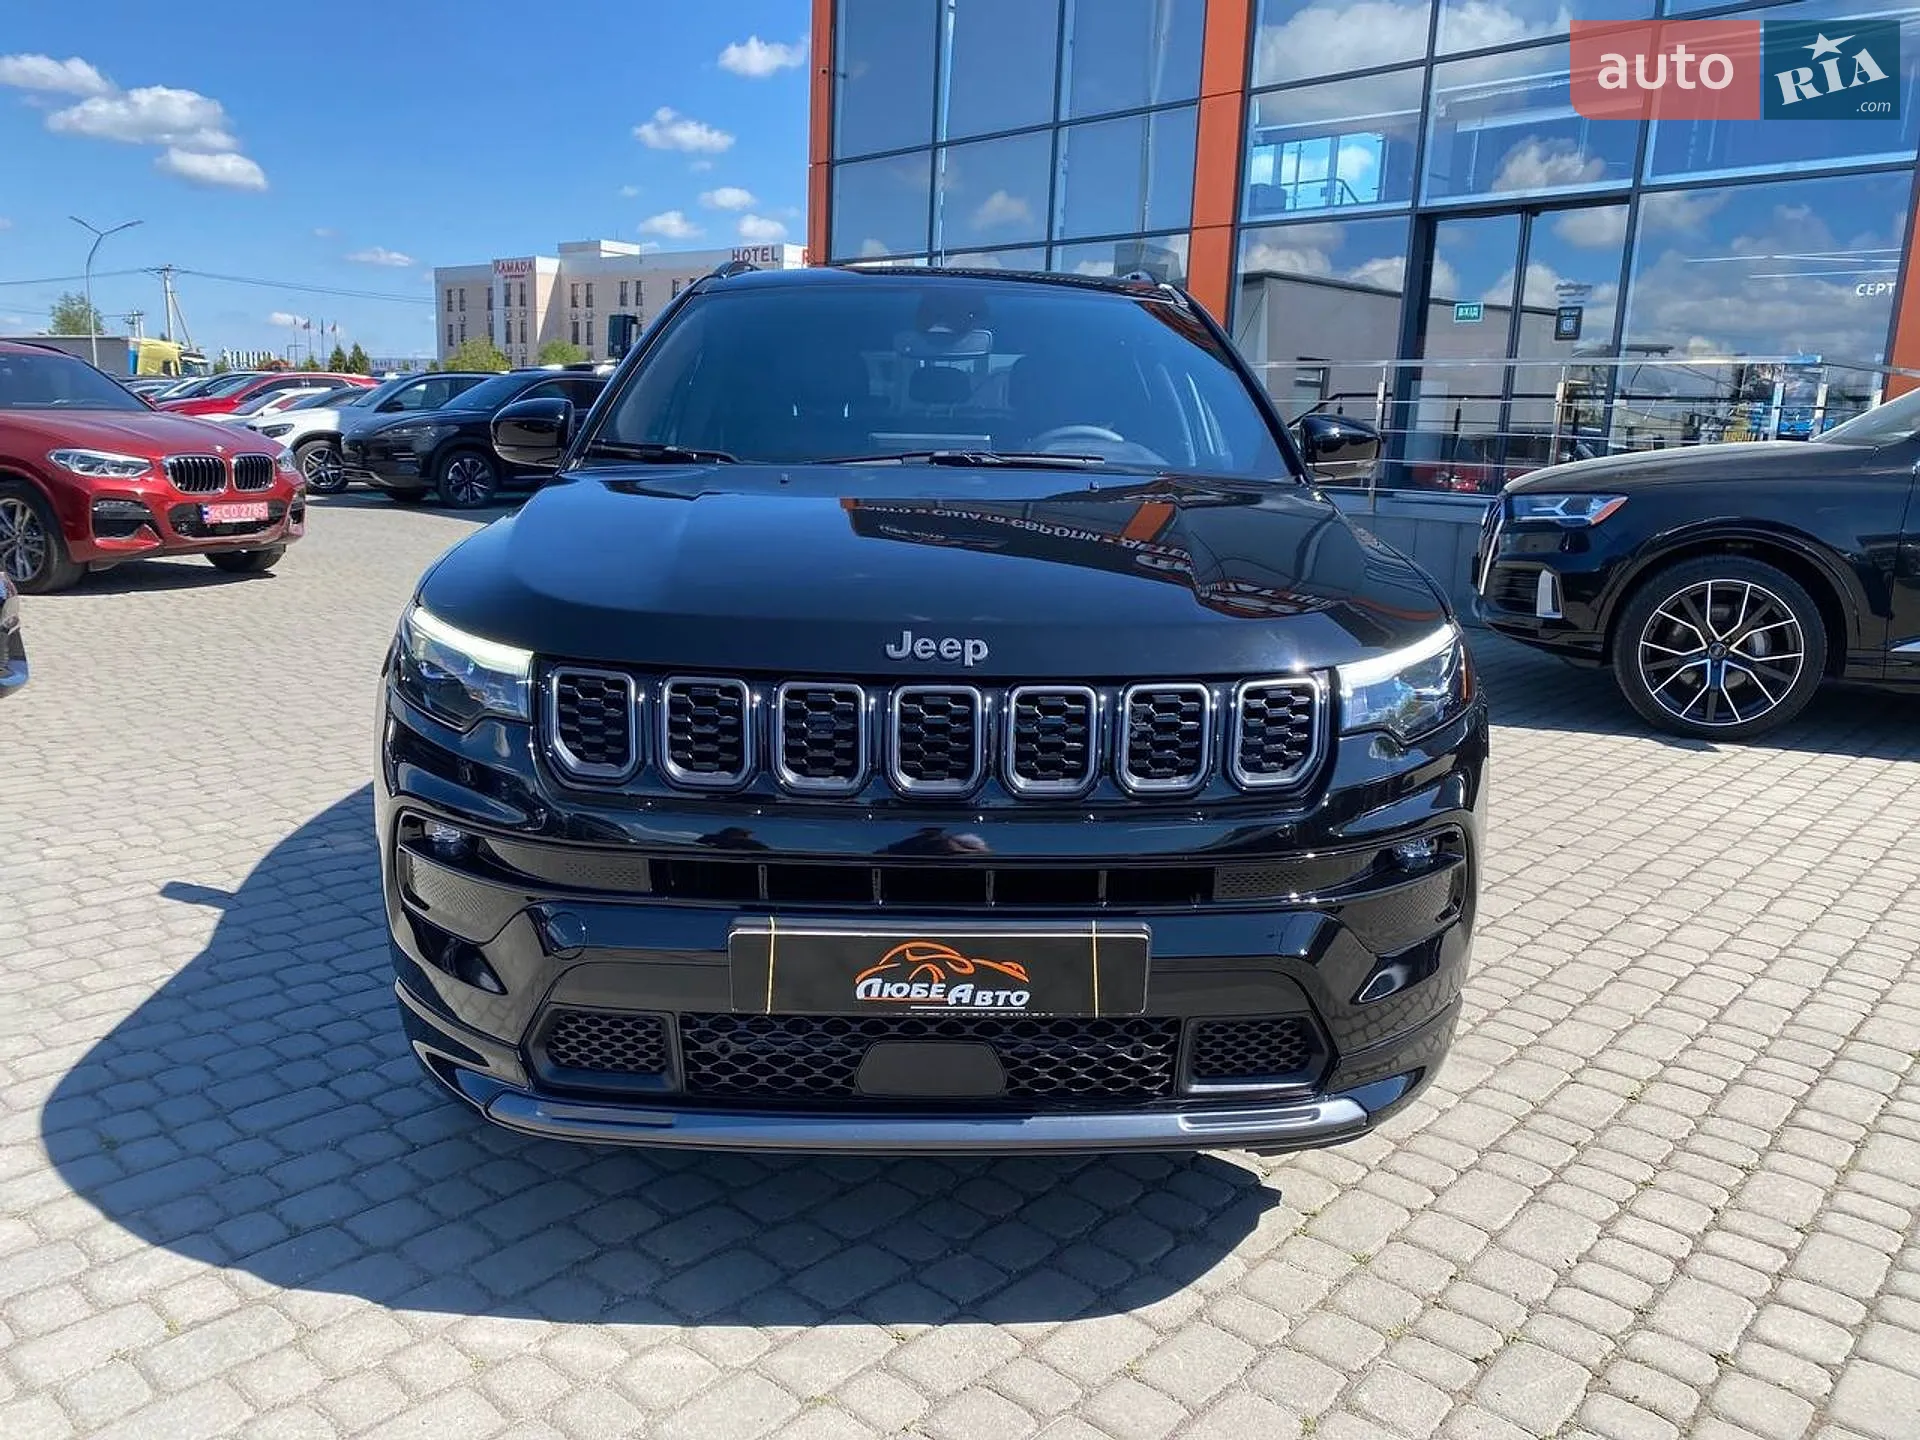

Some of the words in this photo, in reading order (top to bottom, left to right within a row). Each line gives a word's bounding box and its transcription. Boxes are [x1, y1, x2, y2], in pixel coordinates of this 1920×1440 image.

[732, 247, 778, 262] HOTEL
[493, 260, 533, 273] RAMADA
[886, 631, 988, 666] Jeep
